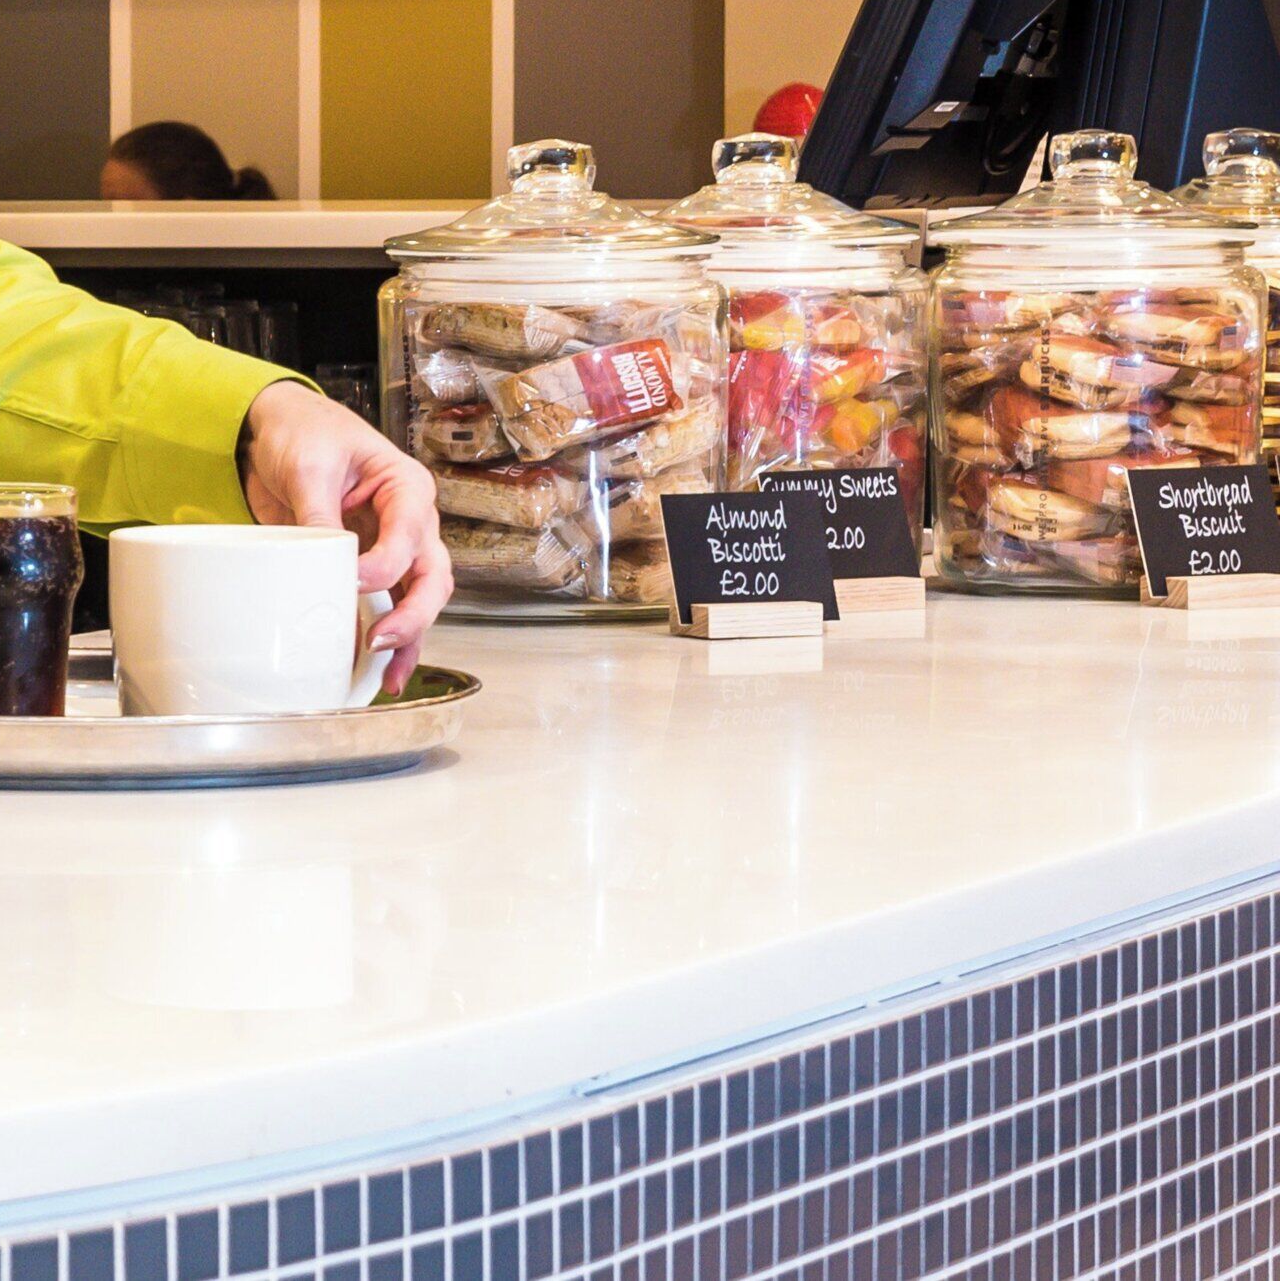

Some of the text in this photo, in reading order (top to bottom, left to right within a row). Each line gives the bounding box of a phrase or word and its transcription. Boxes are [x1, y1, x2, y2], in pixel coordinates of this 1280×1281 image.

[611, 352, 653, 414] BISCOTTI
[634, 351, 668, 407] ALMOND
[840, 472, 897, 498] Sweets
[1158, 475, 1253, 509] Shortbread
[706, 500, 787, 531] Almond
[1178, 506, 1246, 538] Biscuit
[707, 531, 786, 564] Biscotti
[825, 526, 865, 550] 2.00
[1188, 549, 1241, 575] £2.00
[719, 569, 780, 596] £2.00
